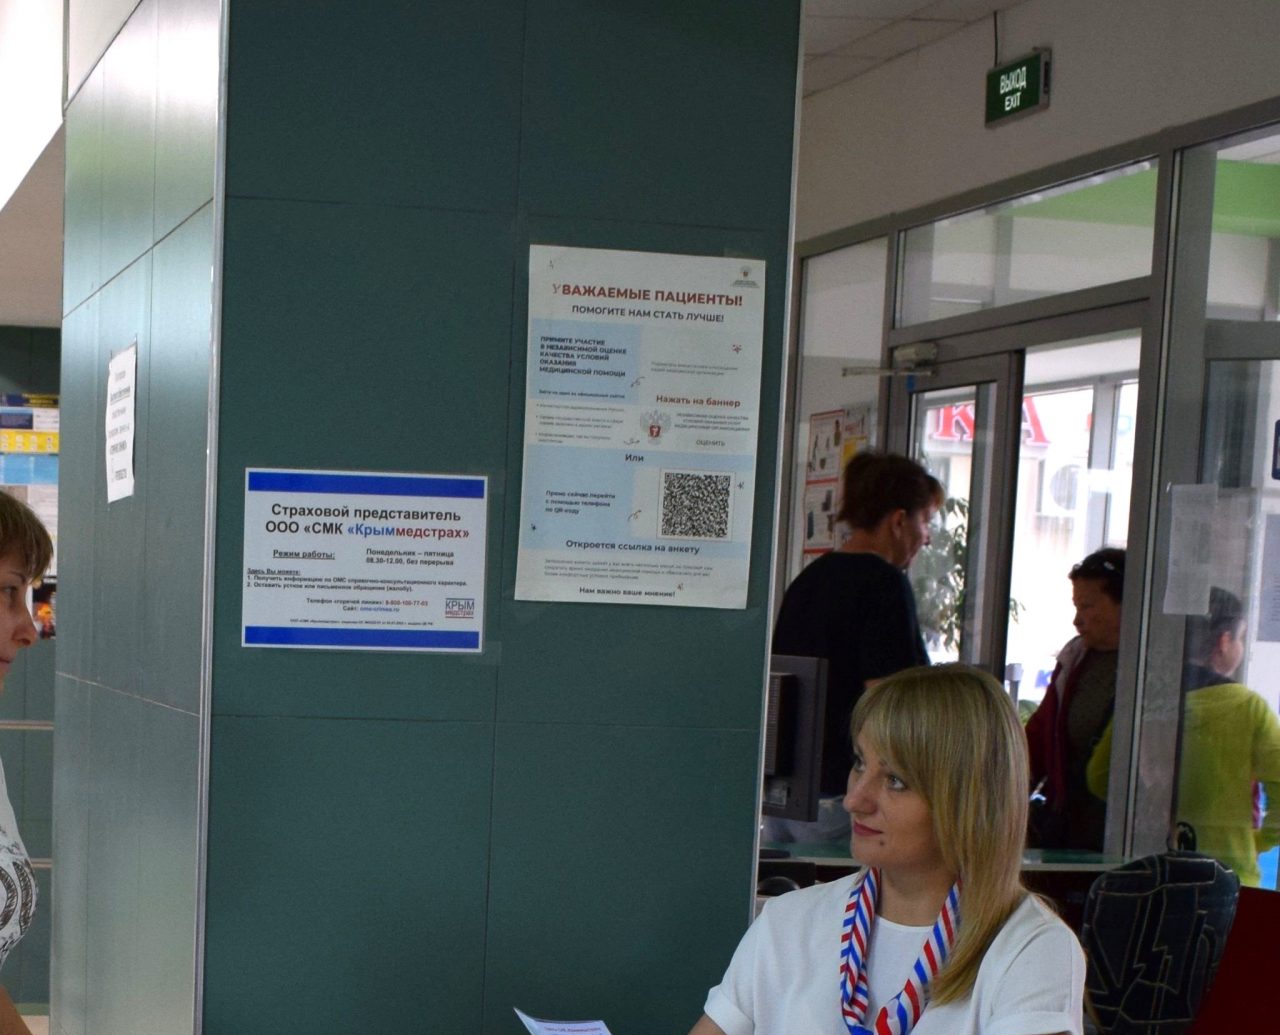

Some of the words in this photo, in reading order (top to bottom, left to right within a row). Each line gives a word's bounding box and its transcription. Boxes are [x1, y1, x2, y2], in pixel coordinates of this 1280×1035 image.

[1000, 66, 1027, 95] ВЫХОД
[1005, 92, 1022, 111] EXIT
[552, 283, 650, 301] УВАЖАЕМЫЕ
[655, 290, 743, 306] ПАЦИЕНТЫ!
[572, 305, 626, 317] ПОМОГИТЕ
[629, 309, 651, 318] НАМ
[653, 310, 684, 320] СТАТЬ
[686, 312, 724, 323] ЛУЧШЕ!
[656, 395, 690, 405] Нажать
[706, 398, 741, 408] баннер
[696, 439, 726, 447] ОЦЕНИТЬ
[625, 454, 644, 463] Или
[271, 503, 350, 518] Страховой
[354, 508, 461, 522] представитель
[265, 521, 300, 534] ООО
[304, 522, 342, 535] «СМК
[347, 522, 470, 539] «Крыммедстрах»
[273, 549, 300, 560] Режим
[301, 550, 335, 560] работы:
[366, 548, 415, 558] Понедельник
[424, 551, 454, 559] пятница
[566, 540, 615, 551] Откроется
[618, 543, 652, 551] ссылка
[668, 546, 700, 556] анкету
[420, 559, 454, 567] перерыва
[579, 587, 595, 595] Нам
[445, 600, 475, 610] КРЫМ
